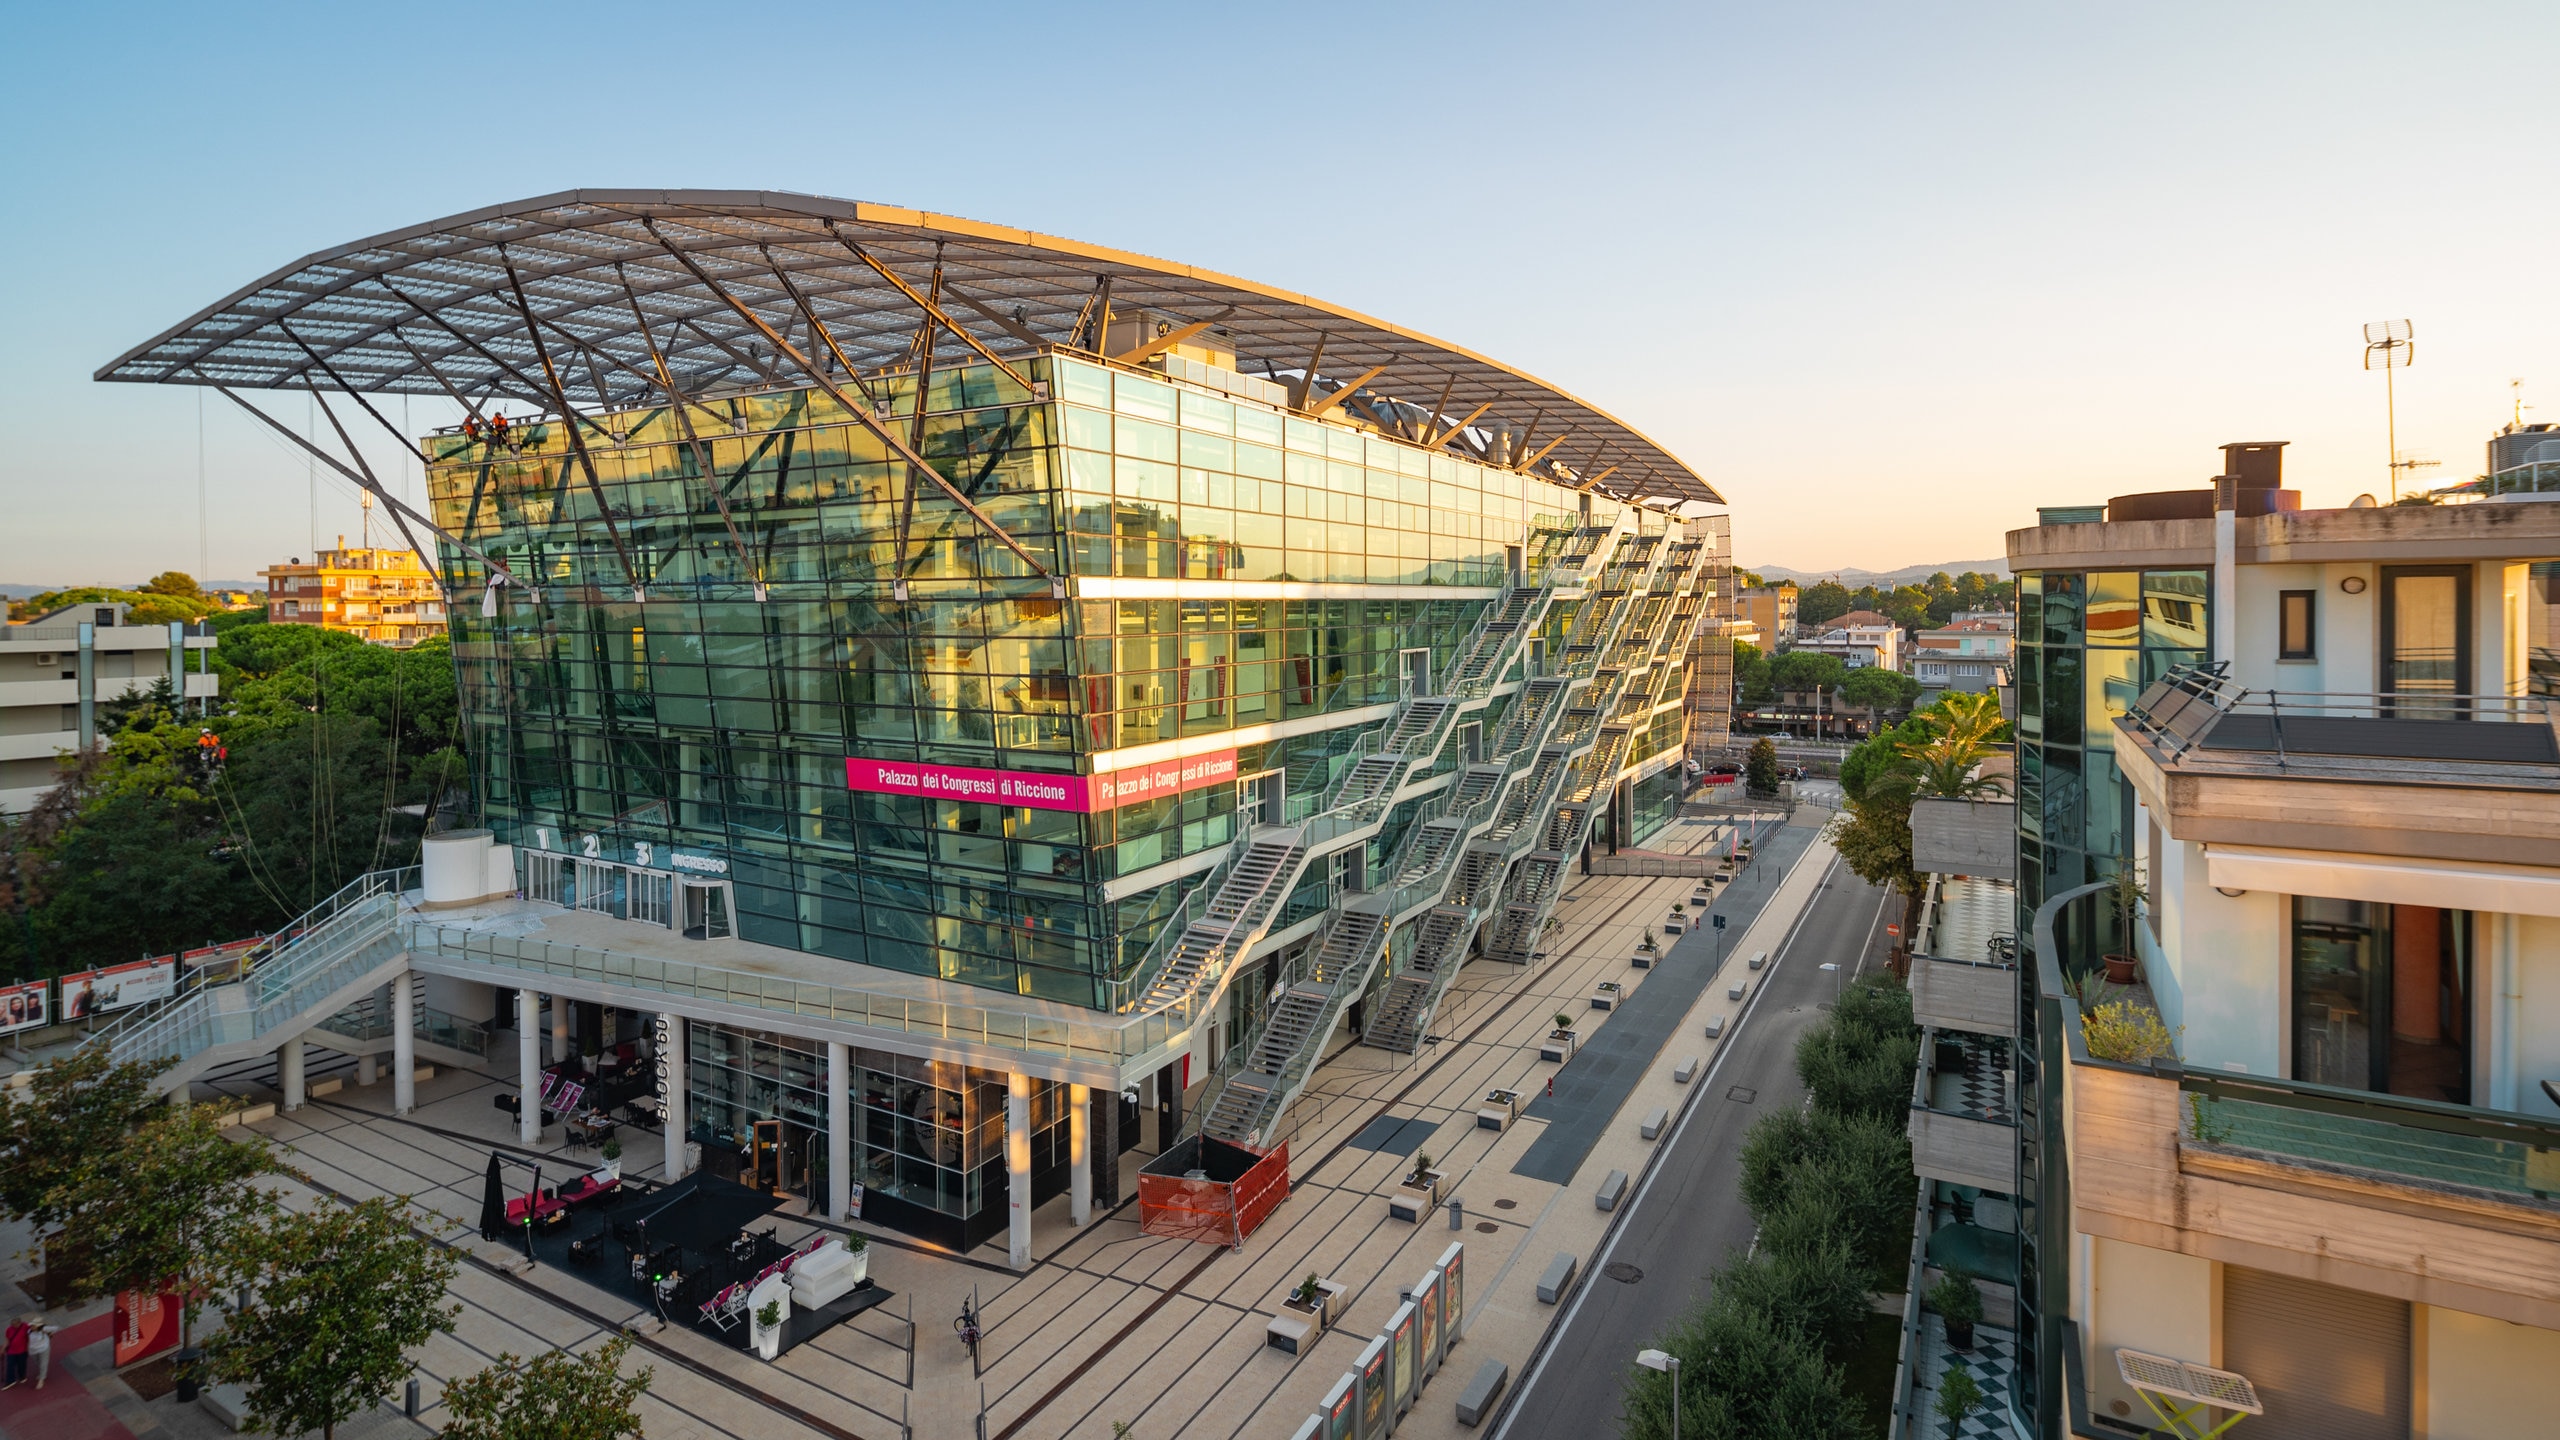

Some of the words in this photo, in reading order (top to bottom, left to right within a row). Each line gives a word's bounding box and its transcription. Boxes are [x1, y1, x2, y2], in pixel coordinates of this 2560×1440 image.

[878, 768, 918, 787] Palazzo
[923, 773, 940, 789] dei
[941, 774, 996, 795] Congressi
[1001, 779, 1011, 796] di
[1015, 780, 1066, 801] Riccione
[1102, 778, 1138, 799] Palazzo
[1139, 774, 1153, 790] dei
[1155, 764, 1197, 788] Congressi
[1197, 762, 1204, 778] di
[1204, 759, 1233, 777] Riccione
[535, 828, 549, 850] 1
[583, 834, 600, 858] 2
[634, 841, 653, 867] 3
[671, 853, 728, 874] INGRESSO
[655, 1018, 670, 1044] 60
[655, 1049, 670, 1123] BLOCK
